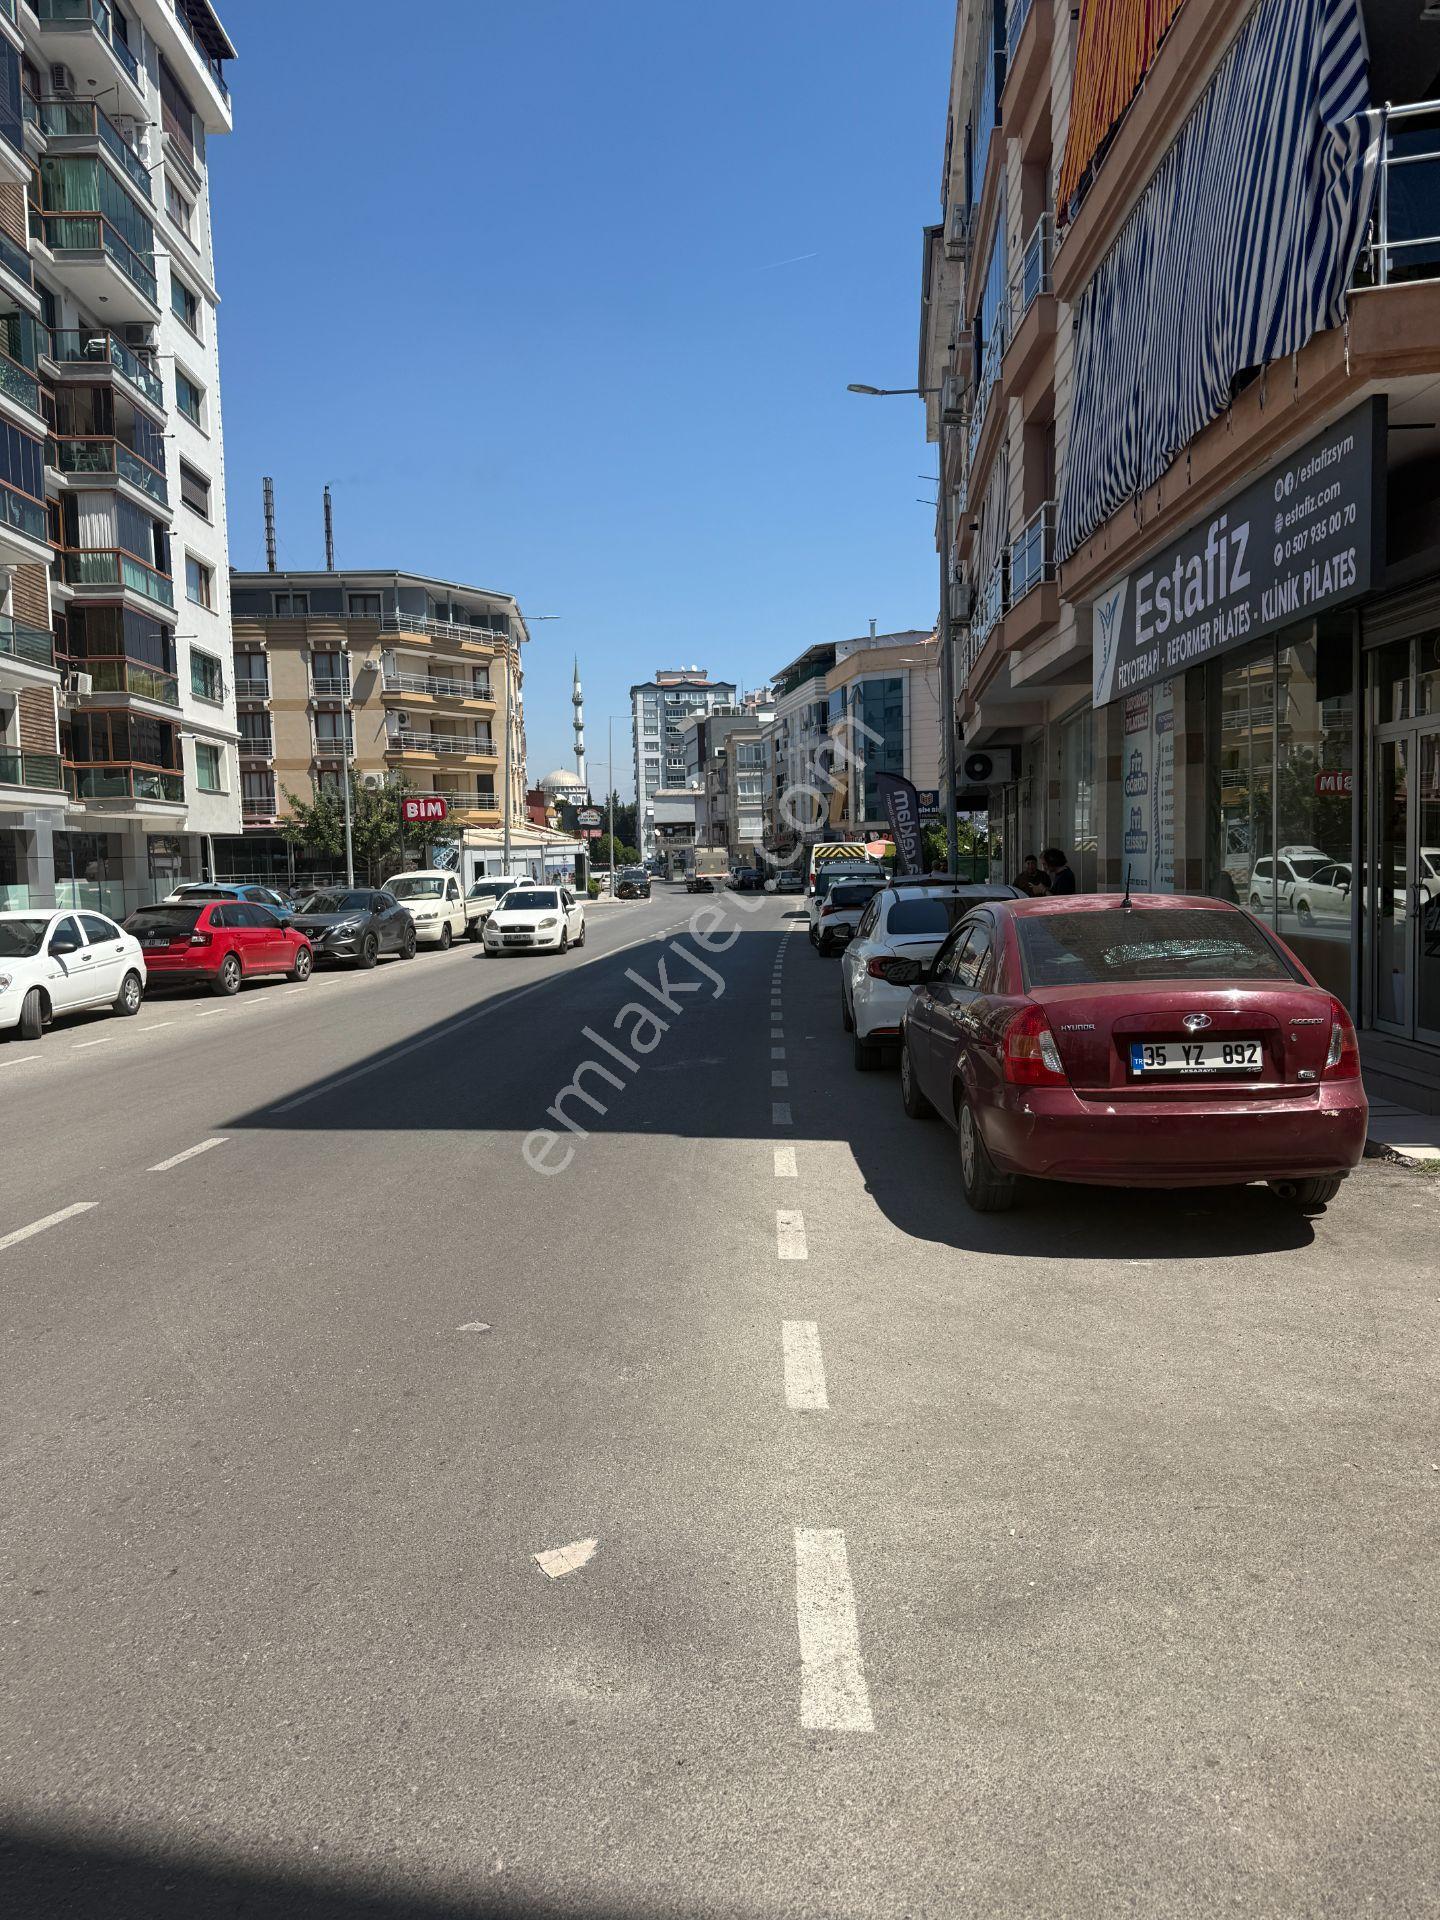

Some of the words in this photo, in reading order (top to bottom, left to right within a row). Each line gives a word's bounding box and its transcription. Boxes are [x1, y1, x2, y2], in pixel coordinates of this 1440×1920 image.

[1285, 480, 1341, 527] estafiz.com
[1285, 540, 1291, 559] 0
[1292, 529, 1308, 554] 507
[1310, 518, 1327, 545] 935
[1329, 510, 1341, 535] 00
[1343, 502, 1356, 527] 70
[1135, 513, 1251, 646] Estafiz
[1118, 641, 1160, 690] FİZYOTERAPİ
[1166, 621, 1211, 668] REFORMER
[1213, 601, 1251, 647] PİLATES
[1261, 570, 1300, 624] KLİNİK
[1303, 547, 1356, 605] PİLATES
[405, 798, 443, 818] BİM
[1143, 1045, 1167, 1067] 35
[1181, 1044, 1205, 1066] YZ
[1222, 1043, 1258, 1065] 892
